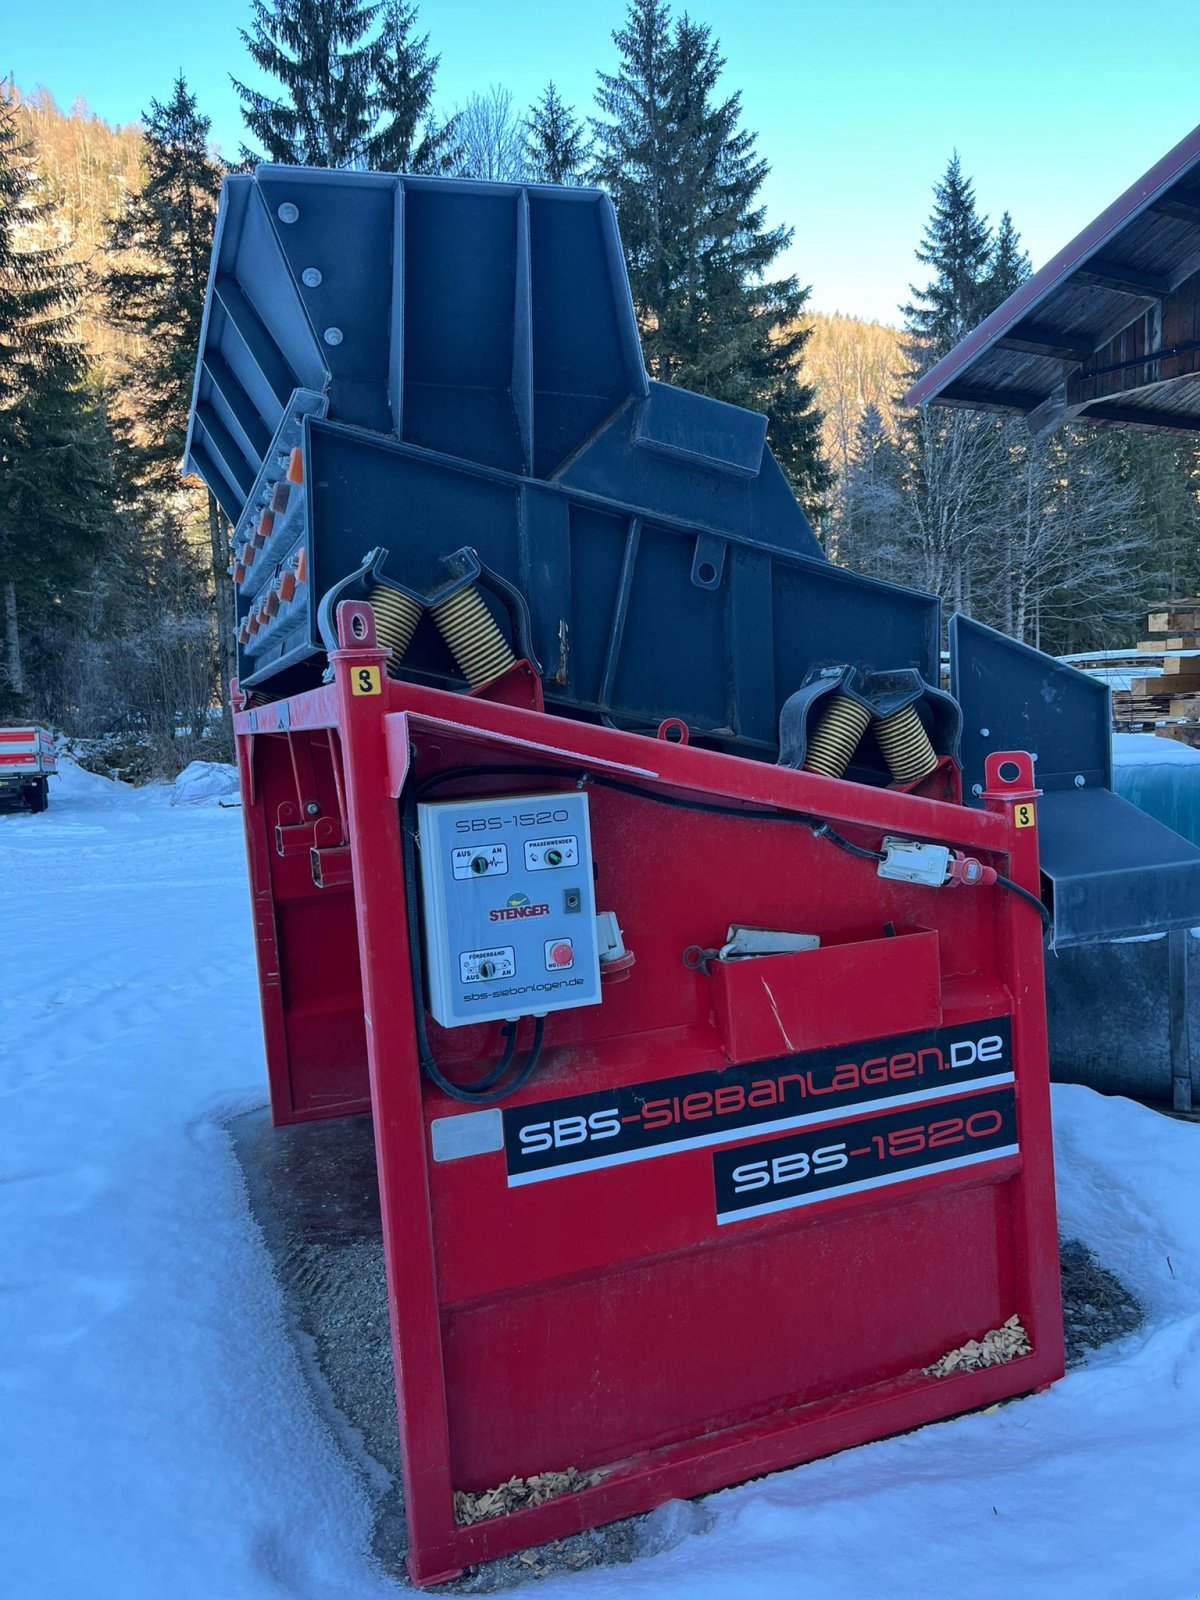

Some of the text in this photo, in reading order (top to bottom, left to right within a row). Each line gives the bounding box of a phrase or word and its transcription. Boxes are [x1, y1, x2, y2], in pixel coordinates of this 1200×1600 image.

[455, 809, 569, 833] SBS-1520
[529, 838, 573, 848] PHASENWENDER
[456, 850, 471, 858] AUS
[489, 904, 550, 922] STENGER
[466, 974, 480, 982] AUS
[731, 1109, 1003, 1194] SBS-1520
